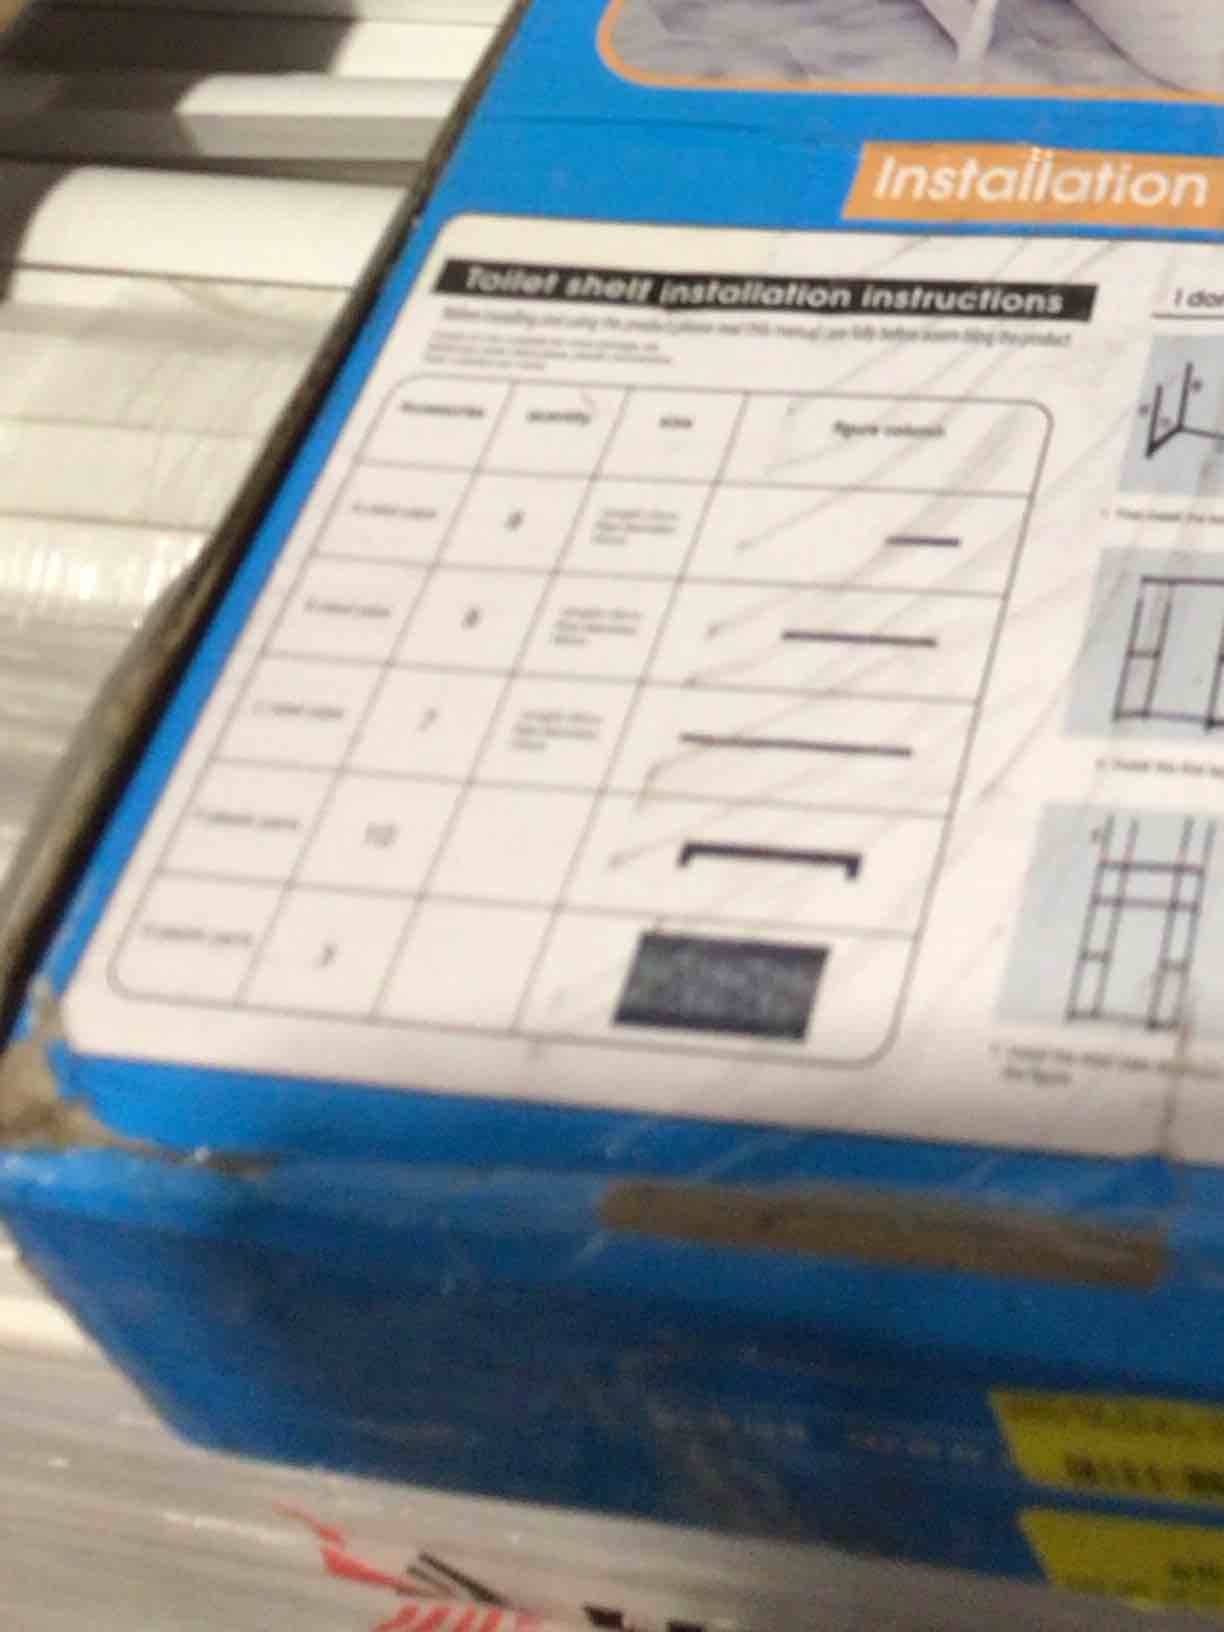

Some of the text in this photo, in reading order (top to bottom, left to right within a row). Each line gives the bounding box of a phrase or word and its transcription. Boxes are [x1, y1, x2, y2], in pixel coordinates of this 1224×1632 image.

[872, 150, 1208, 209] Installation
[465, 265, 1065, 315] Toilet shelf installation instructions
